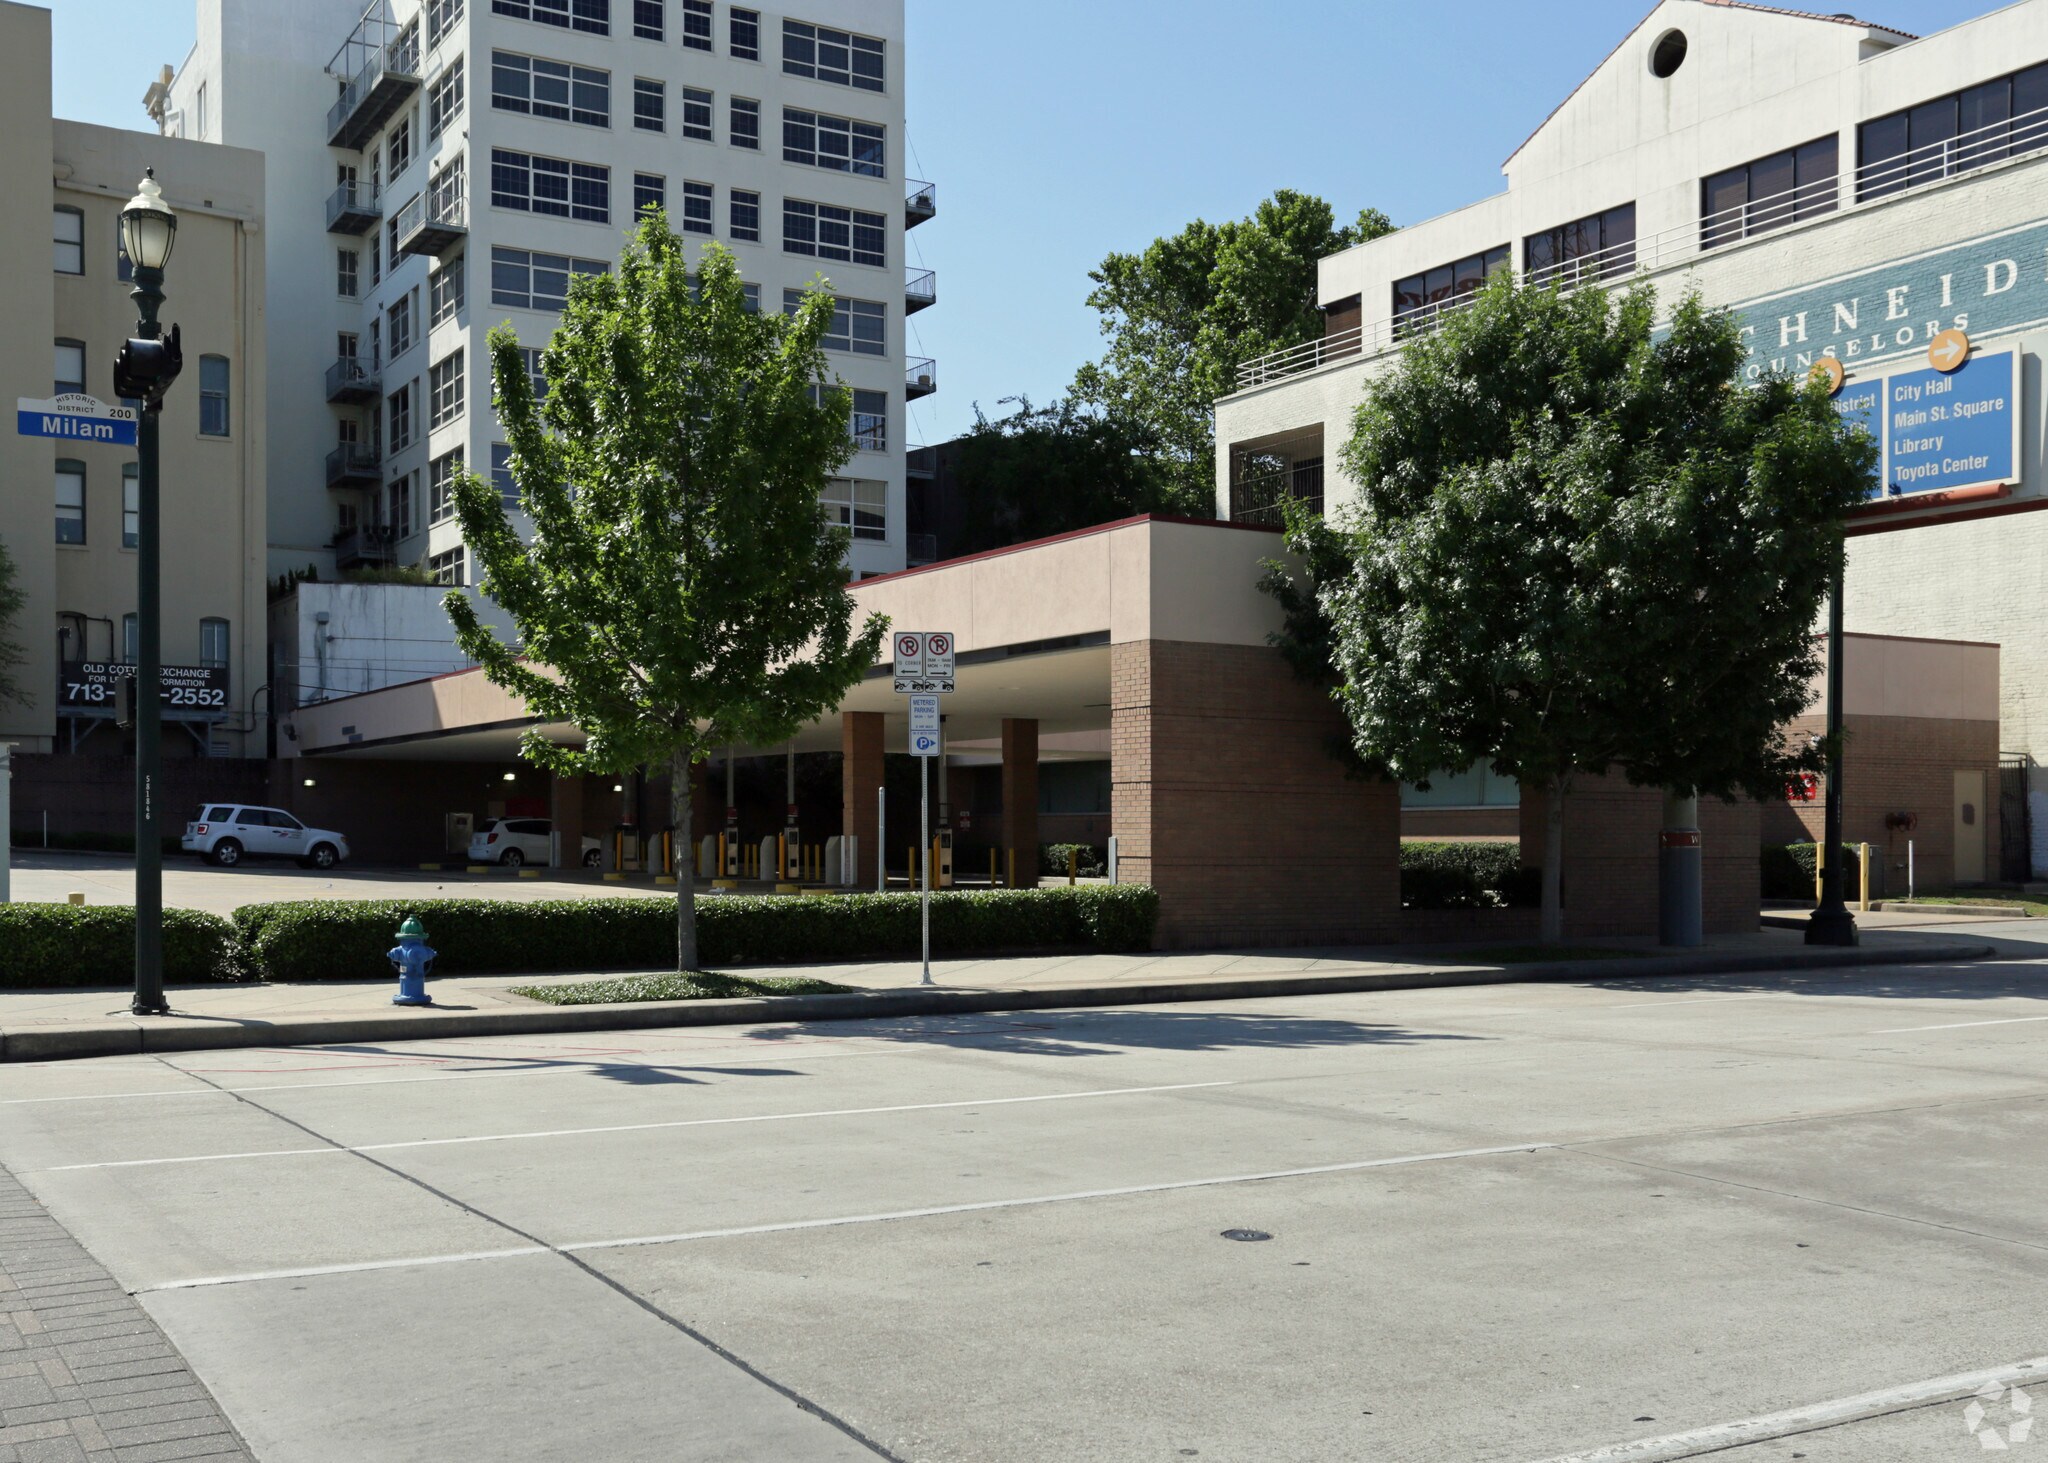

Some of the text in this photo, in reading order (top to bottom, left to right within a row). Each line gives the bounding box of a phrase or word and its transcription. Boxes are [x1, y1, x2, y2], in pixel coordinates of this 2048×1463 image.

[1746, 313, 1969, 379] OUNSELORS
[1895, 376, 1952, 402] City Hall
[55, 394, 96, 406] HISTORIC
[57, 405, 94, 413] DISTRICT
[109, 408, 131, 419] 200
[1894, 398, 2004, 429] Main St. Square
[42, 416, 113, 439] Milam
[1894, 435, 1944, 455] Library
[1894, 456, 1989, 482] Toyota Center
[83, 664, 105, 673] OLD
[109, 665, 137, 675] COTT
[88, 675, 106, 683] FOR
[160, 678, 205, 687] ORMATION
